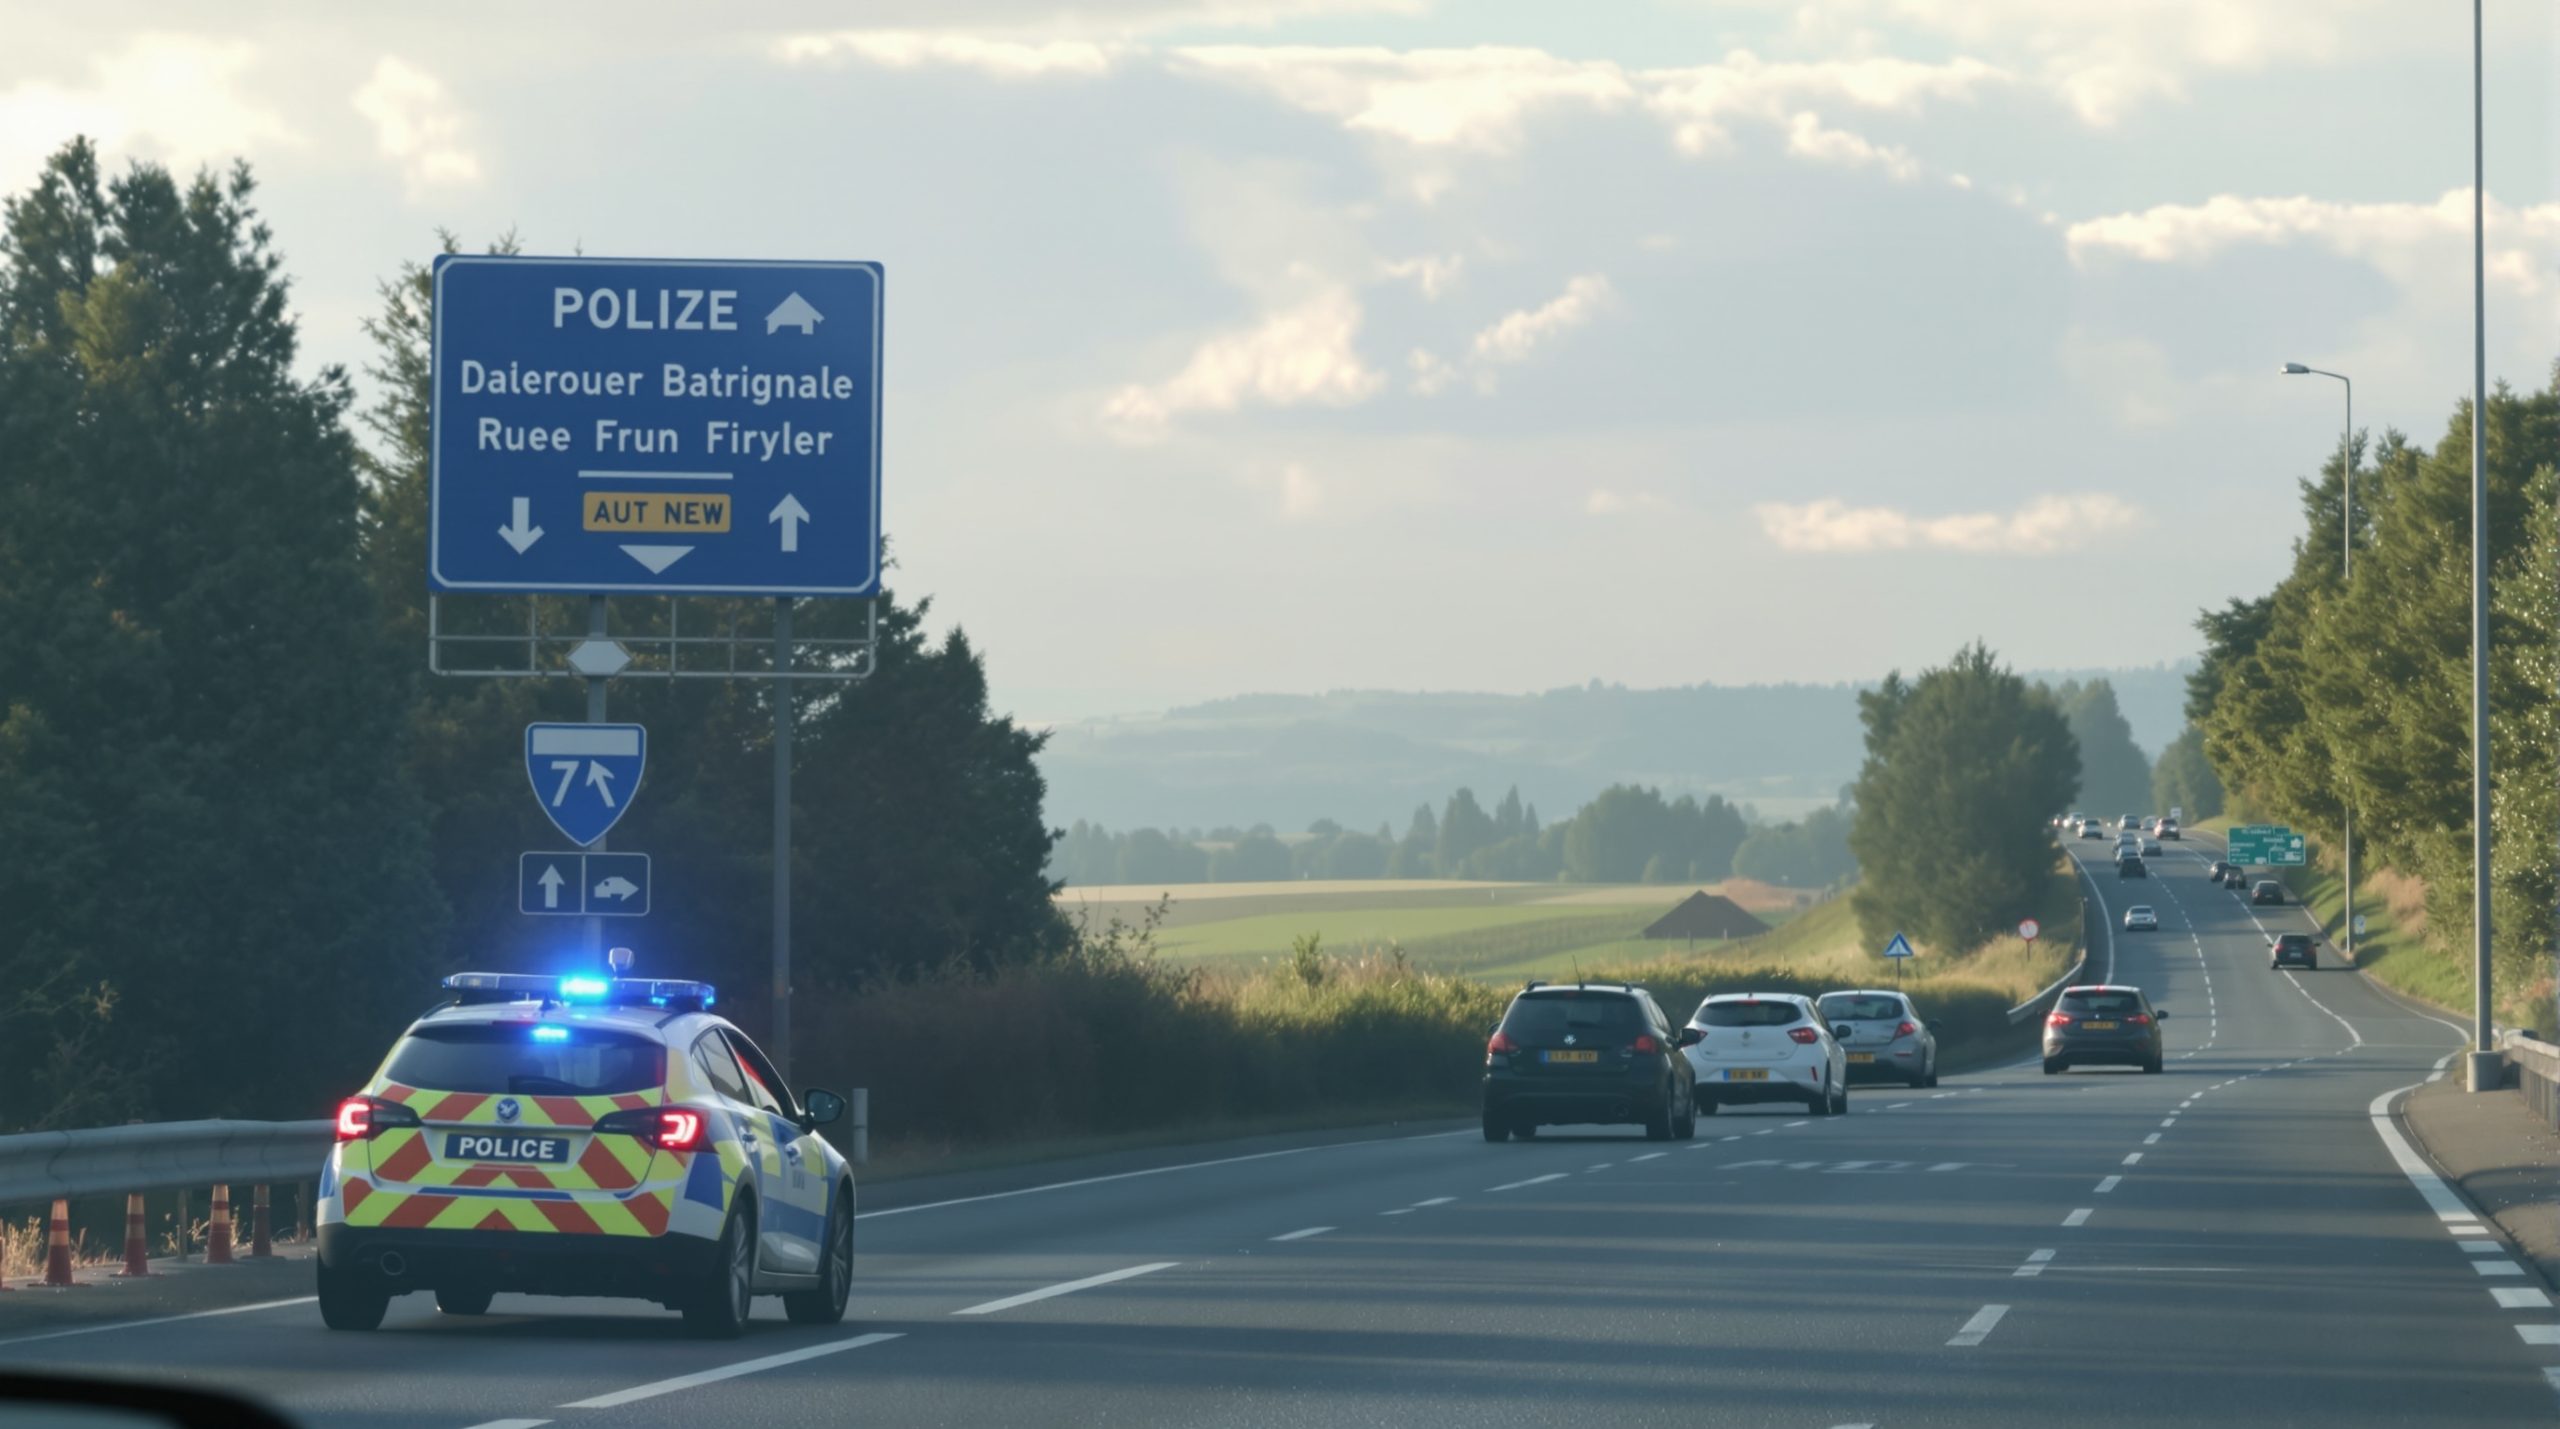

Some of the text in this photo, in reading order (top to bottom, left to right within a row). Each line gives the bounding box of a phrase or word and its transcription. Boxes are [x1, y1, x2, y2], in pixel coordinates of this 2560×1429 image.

[553, 287, 739, 331] POLIZE
[663, 363, 854, 406] Batrignale
[478, 417, 834, 462] Ruee Frun Firyler
[593, 500, 724, 525] AUT NEW
[551, 760, 580, 807] 7
[458, 1136, 556, 1160] POLICE
